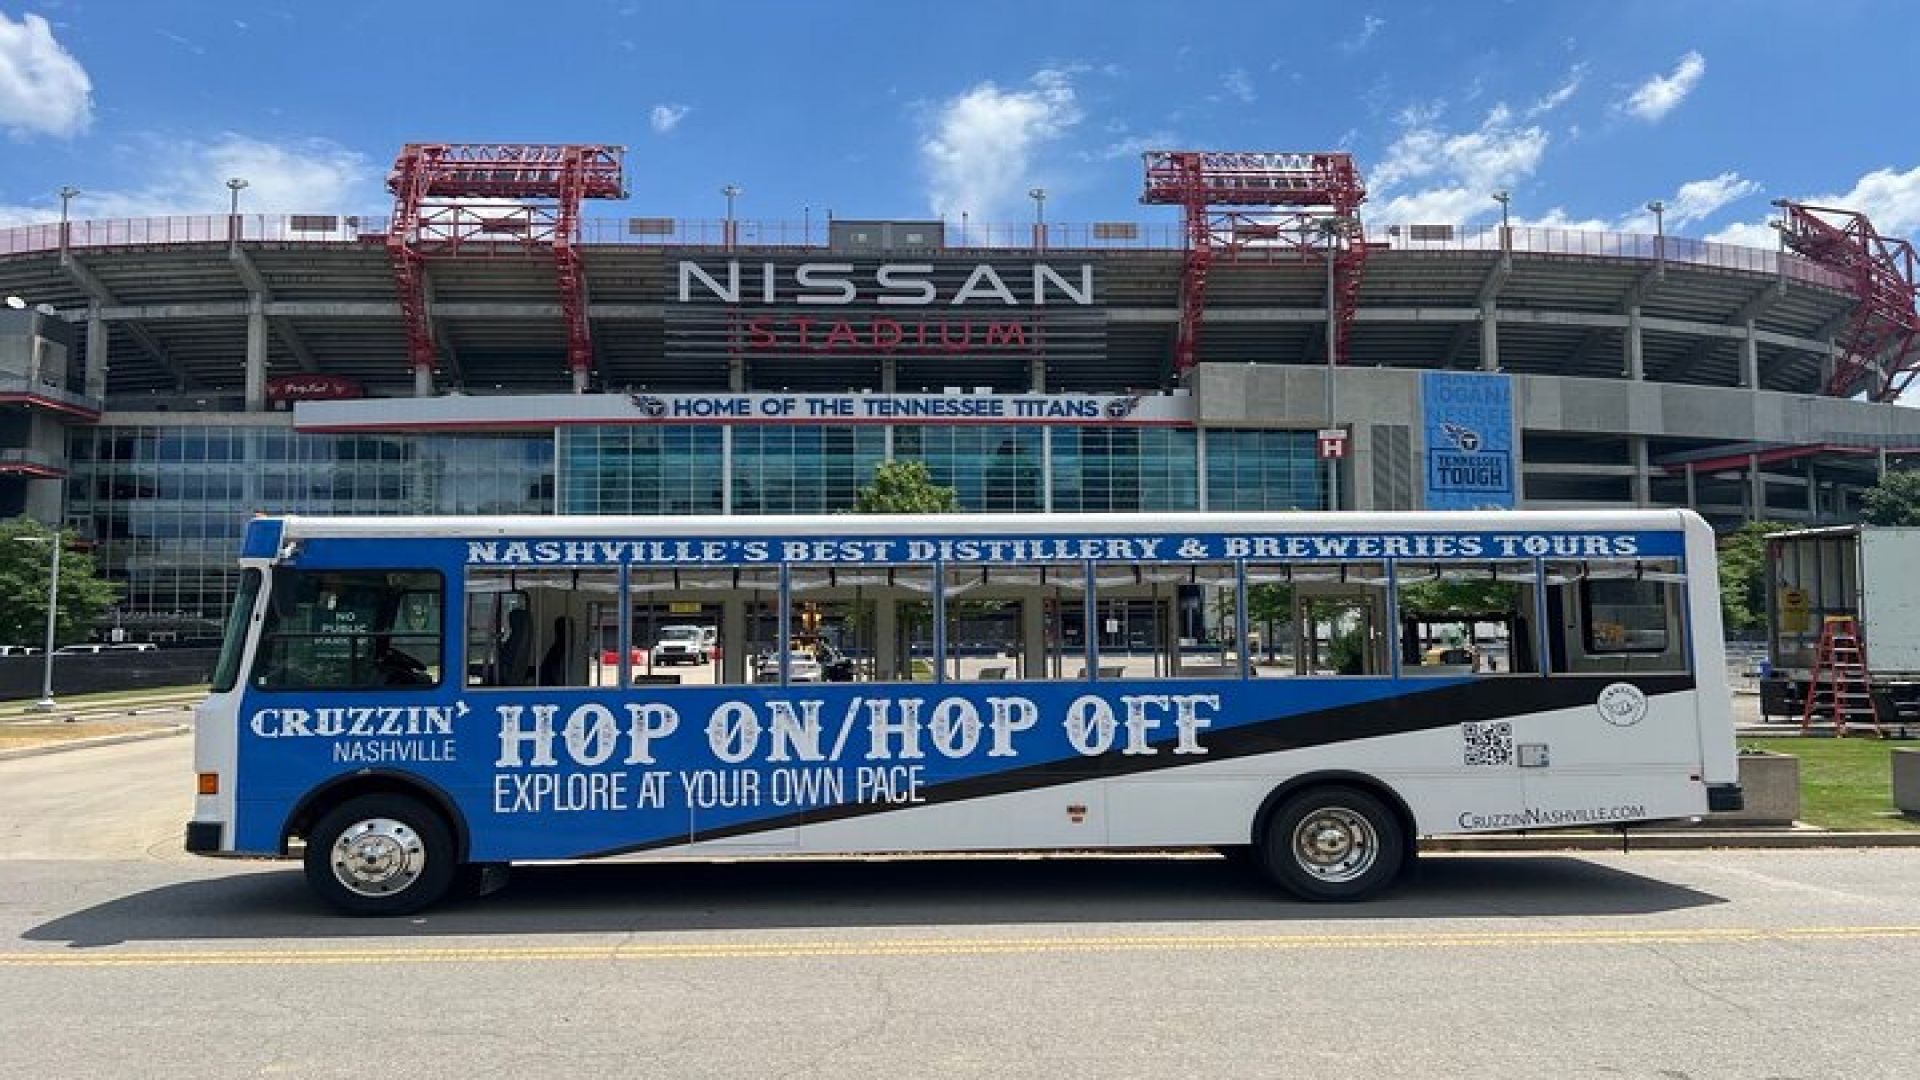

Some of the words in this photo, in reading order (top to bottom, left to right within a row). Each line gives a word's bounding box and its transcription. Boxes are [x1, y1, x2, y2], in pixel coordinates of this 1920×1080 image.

[679, 261, 1095, 304] NISSAN
[748, 318, 1026, 350] STADIUM
[674, 397, 752, 417] HOME
[760, 398, 796, 417] OF
[805, 398, 854, 417] THE
[864, 399, 1003, 417] TENNESSEE
[1012, 399, 1100, 417] TITANS
[1323, 440, 1342, 457] H
[1438, 456, 1501, 468] TENNESSEE
[1437, 467, 1503, 487] TOUGH
[466, 541, 769, 563] NASHVILLE'S
[782, 541, 897, 561] BEST
[906, 538, 1163, 561] DISTILLERY
[1177, 538, 1209, 559] &
[1223, 535, 1484, 558] BREWERIES
[1493, 534, 1639, 557] TOURS
[250, 699, 471, 738] CRUZZIN'
[495, 702, 680, 768] HOP
[1063, 694, 1221, 757] OFF
[333, 739, 456, 762] NASHVILLE
[495, 773, 628, 813] EXPLORE
[637, 771, 672, 811] AT
[680, 769, 760, 809] YOUR
[772, 766, 844, 806] OWN
[856, 764, 926, 804] PACE
